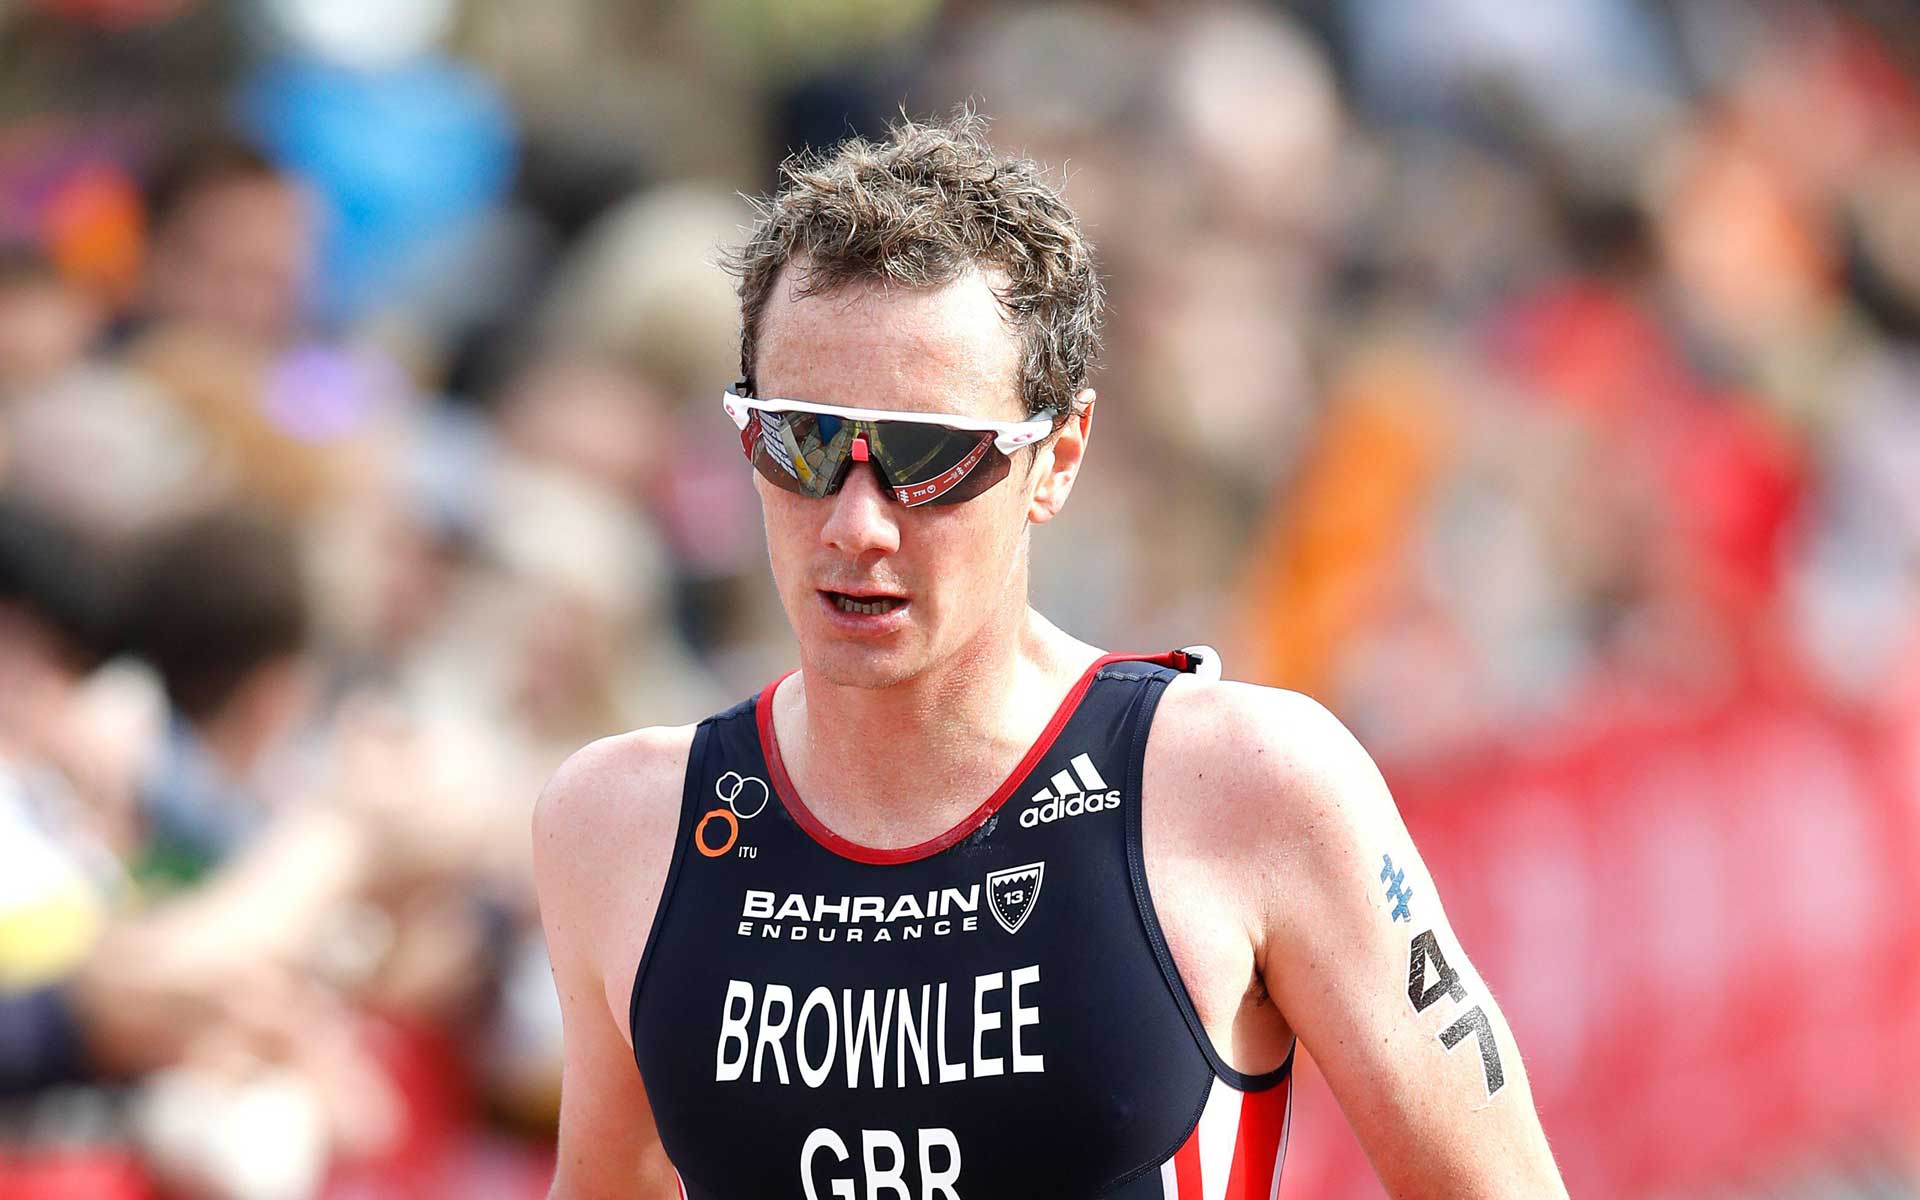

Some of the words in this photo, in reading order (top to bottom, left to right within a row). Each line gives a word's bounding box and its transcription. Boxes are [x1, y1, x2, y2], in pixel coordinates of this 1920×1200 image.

[1019, 790, 1121, 829] adidas
[738, 846, 758, 859] ITU
[742, 884, 981, 923] BAHRAIN
[1003, 890, 1025, 906] 13
[737, 916, 979, 943] ENDURANCE
[715, 964, 1045, 1089] BROWNLEE
[800, 1127, 963, 1200] GBR
